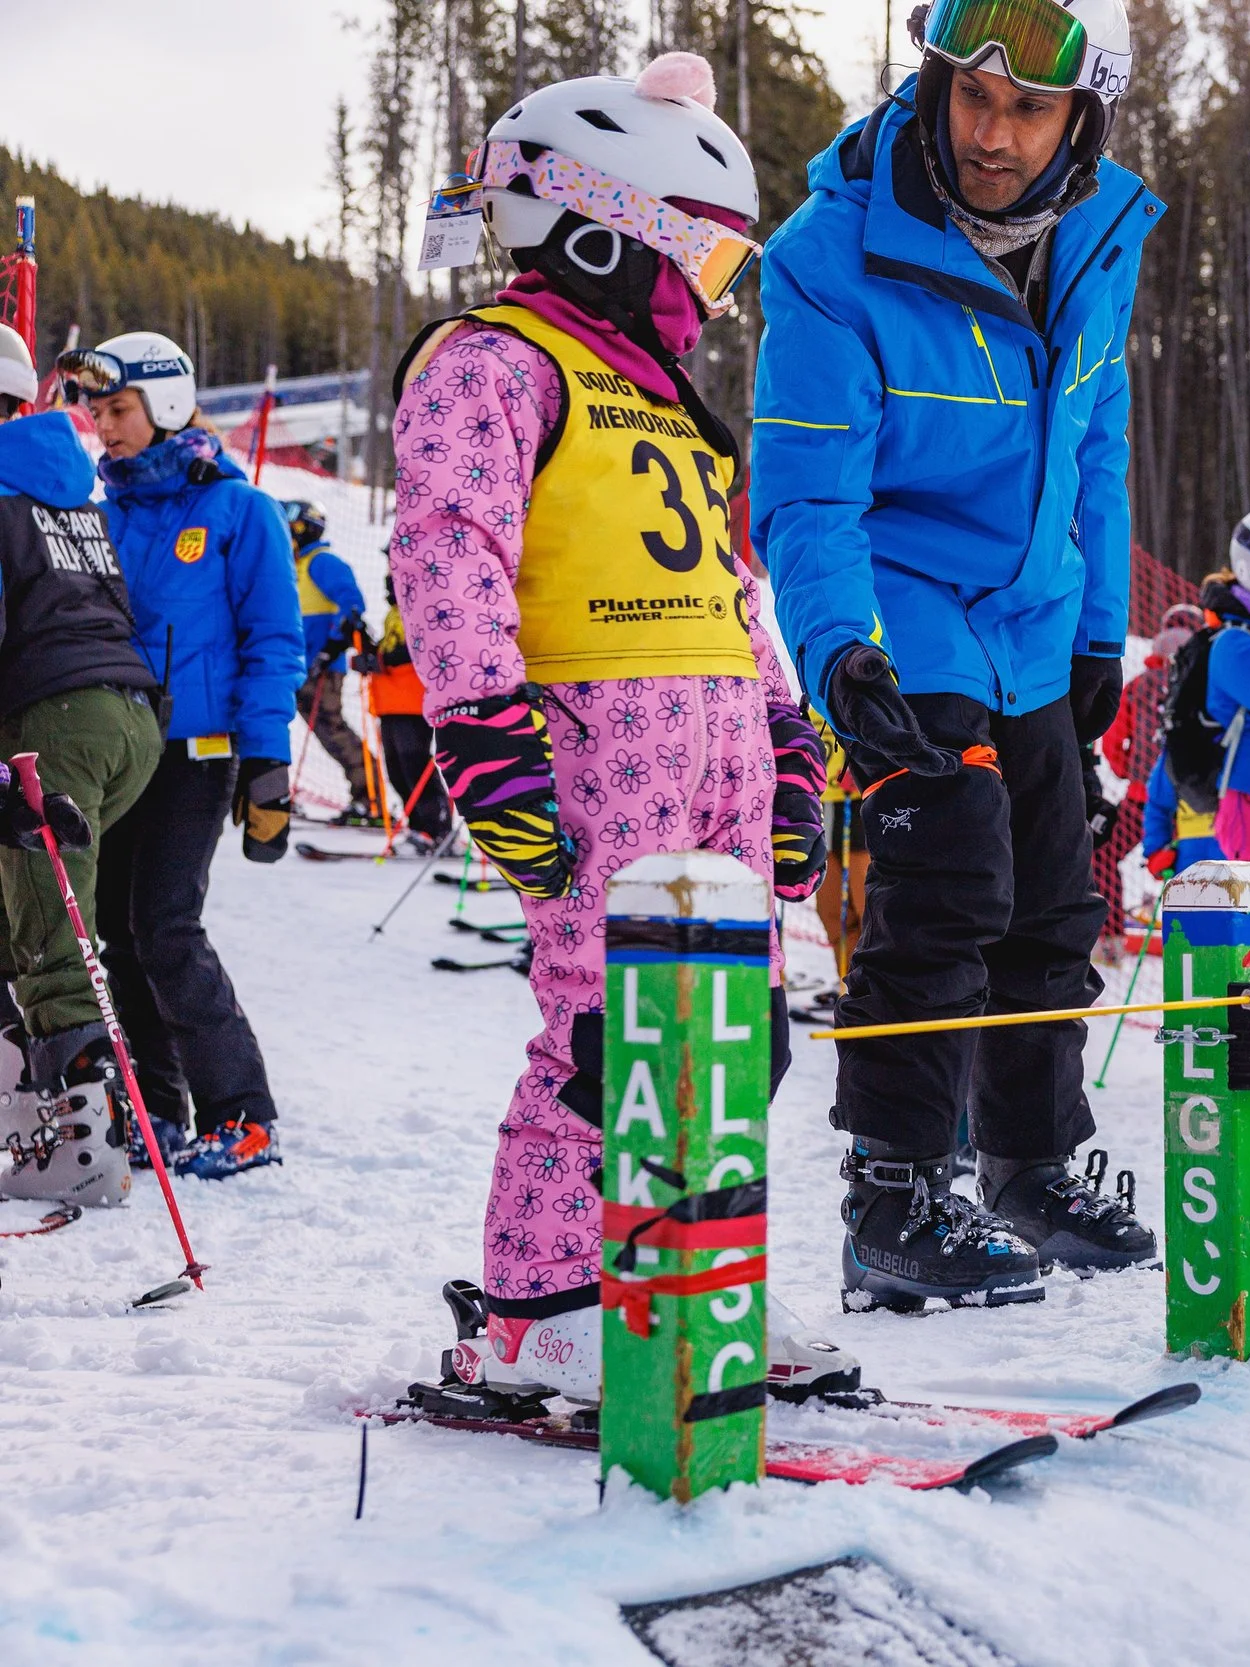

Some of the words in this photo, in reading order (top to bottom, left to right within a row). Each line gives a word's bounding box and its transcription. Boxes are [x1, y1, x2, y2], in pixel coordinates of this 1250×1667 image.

[573, 370, 634, 397] DOUG
[587, 404, 700, 439] MEMORIAL
[632, 440, 737, 577] 35
[588, 595, 704, 613] Plutonic
[604, 612, 662, 624] POWER
[77, 936, 122, 1043] ATOMIC
[859, 1244, 919, 1279] DALBELLO
[534, 1327, 574, 1364] G30
